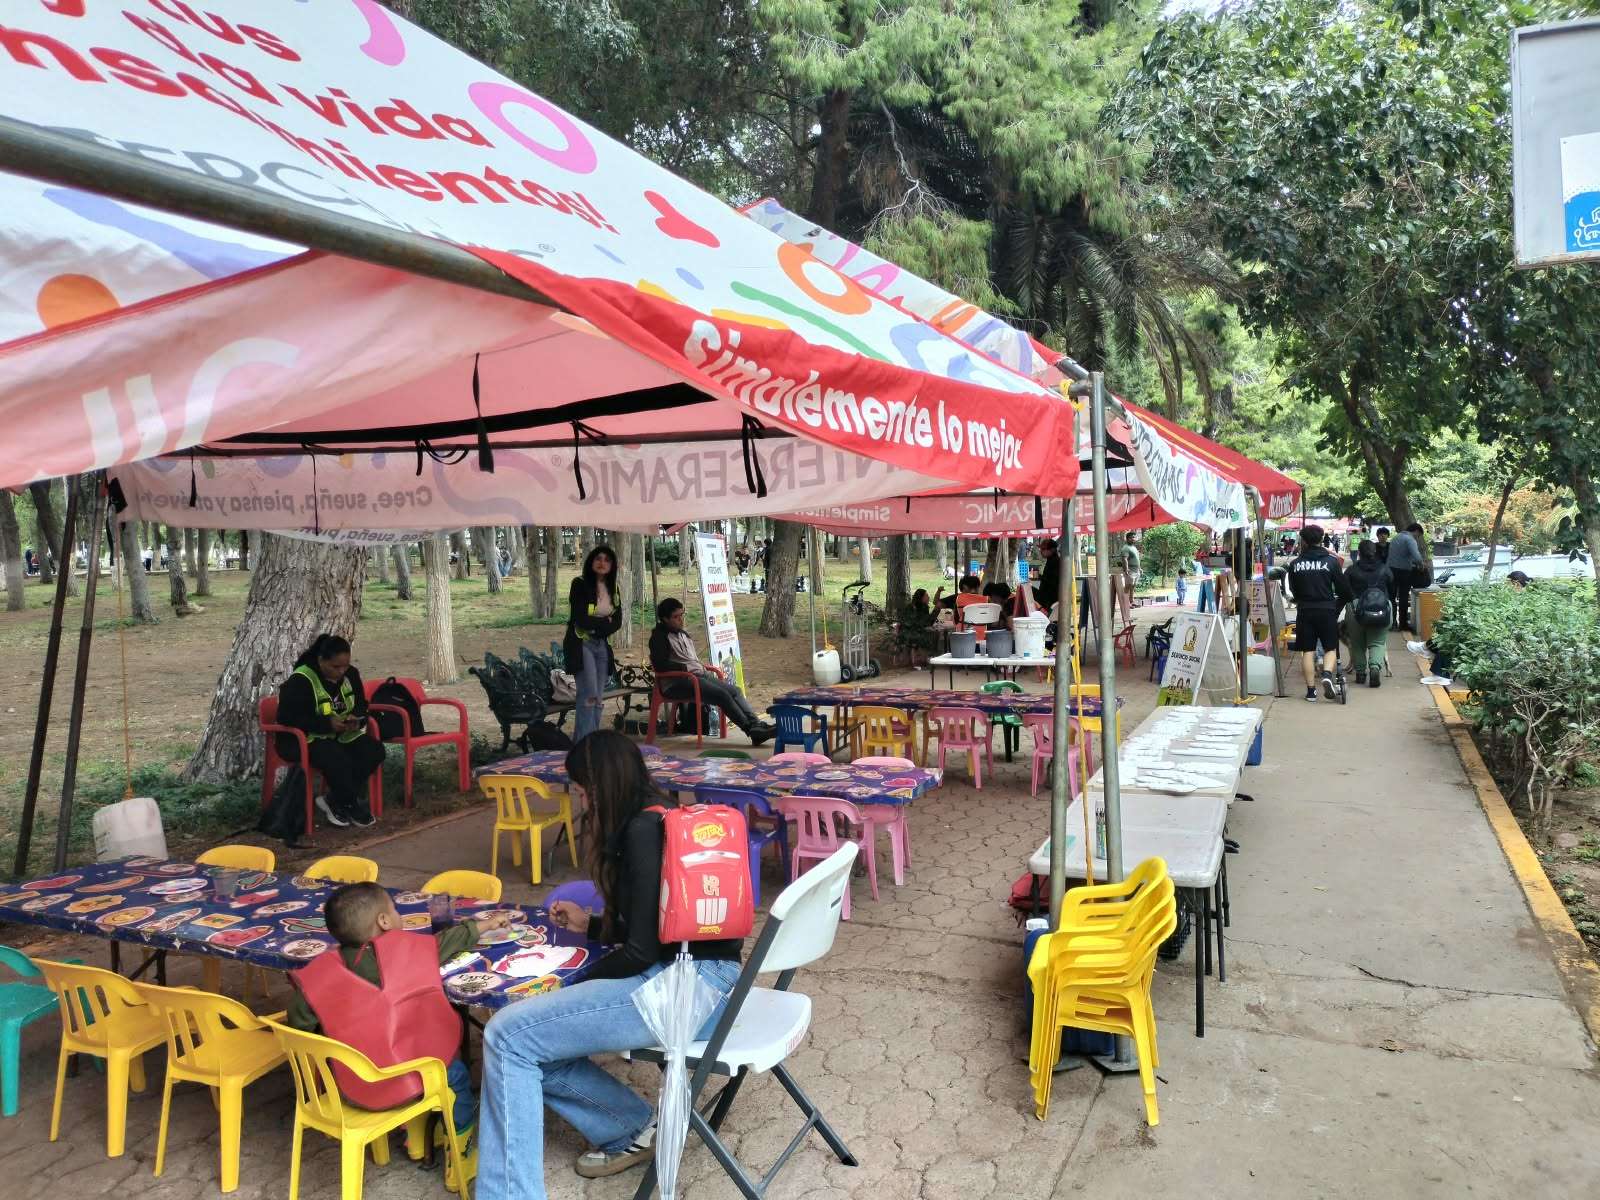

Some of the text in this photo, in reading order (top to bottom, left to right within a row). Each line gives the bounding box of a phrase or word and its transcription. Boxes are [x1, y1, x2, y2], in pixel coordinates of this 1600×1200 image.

[278, 83, 496, 149] vida
[938, 399, 963, 454] lo
[967, 418, 1023, 476] mejor
[1293, 560, 1321, 573] JORDAN
